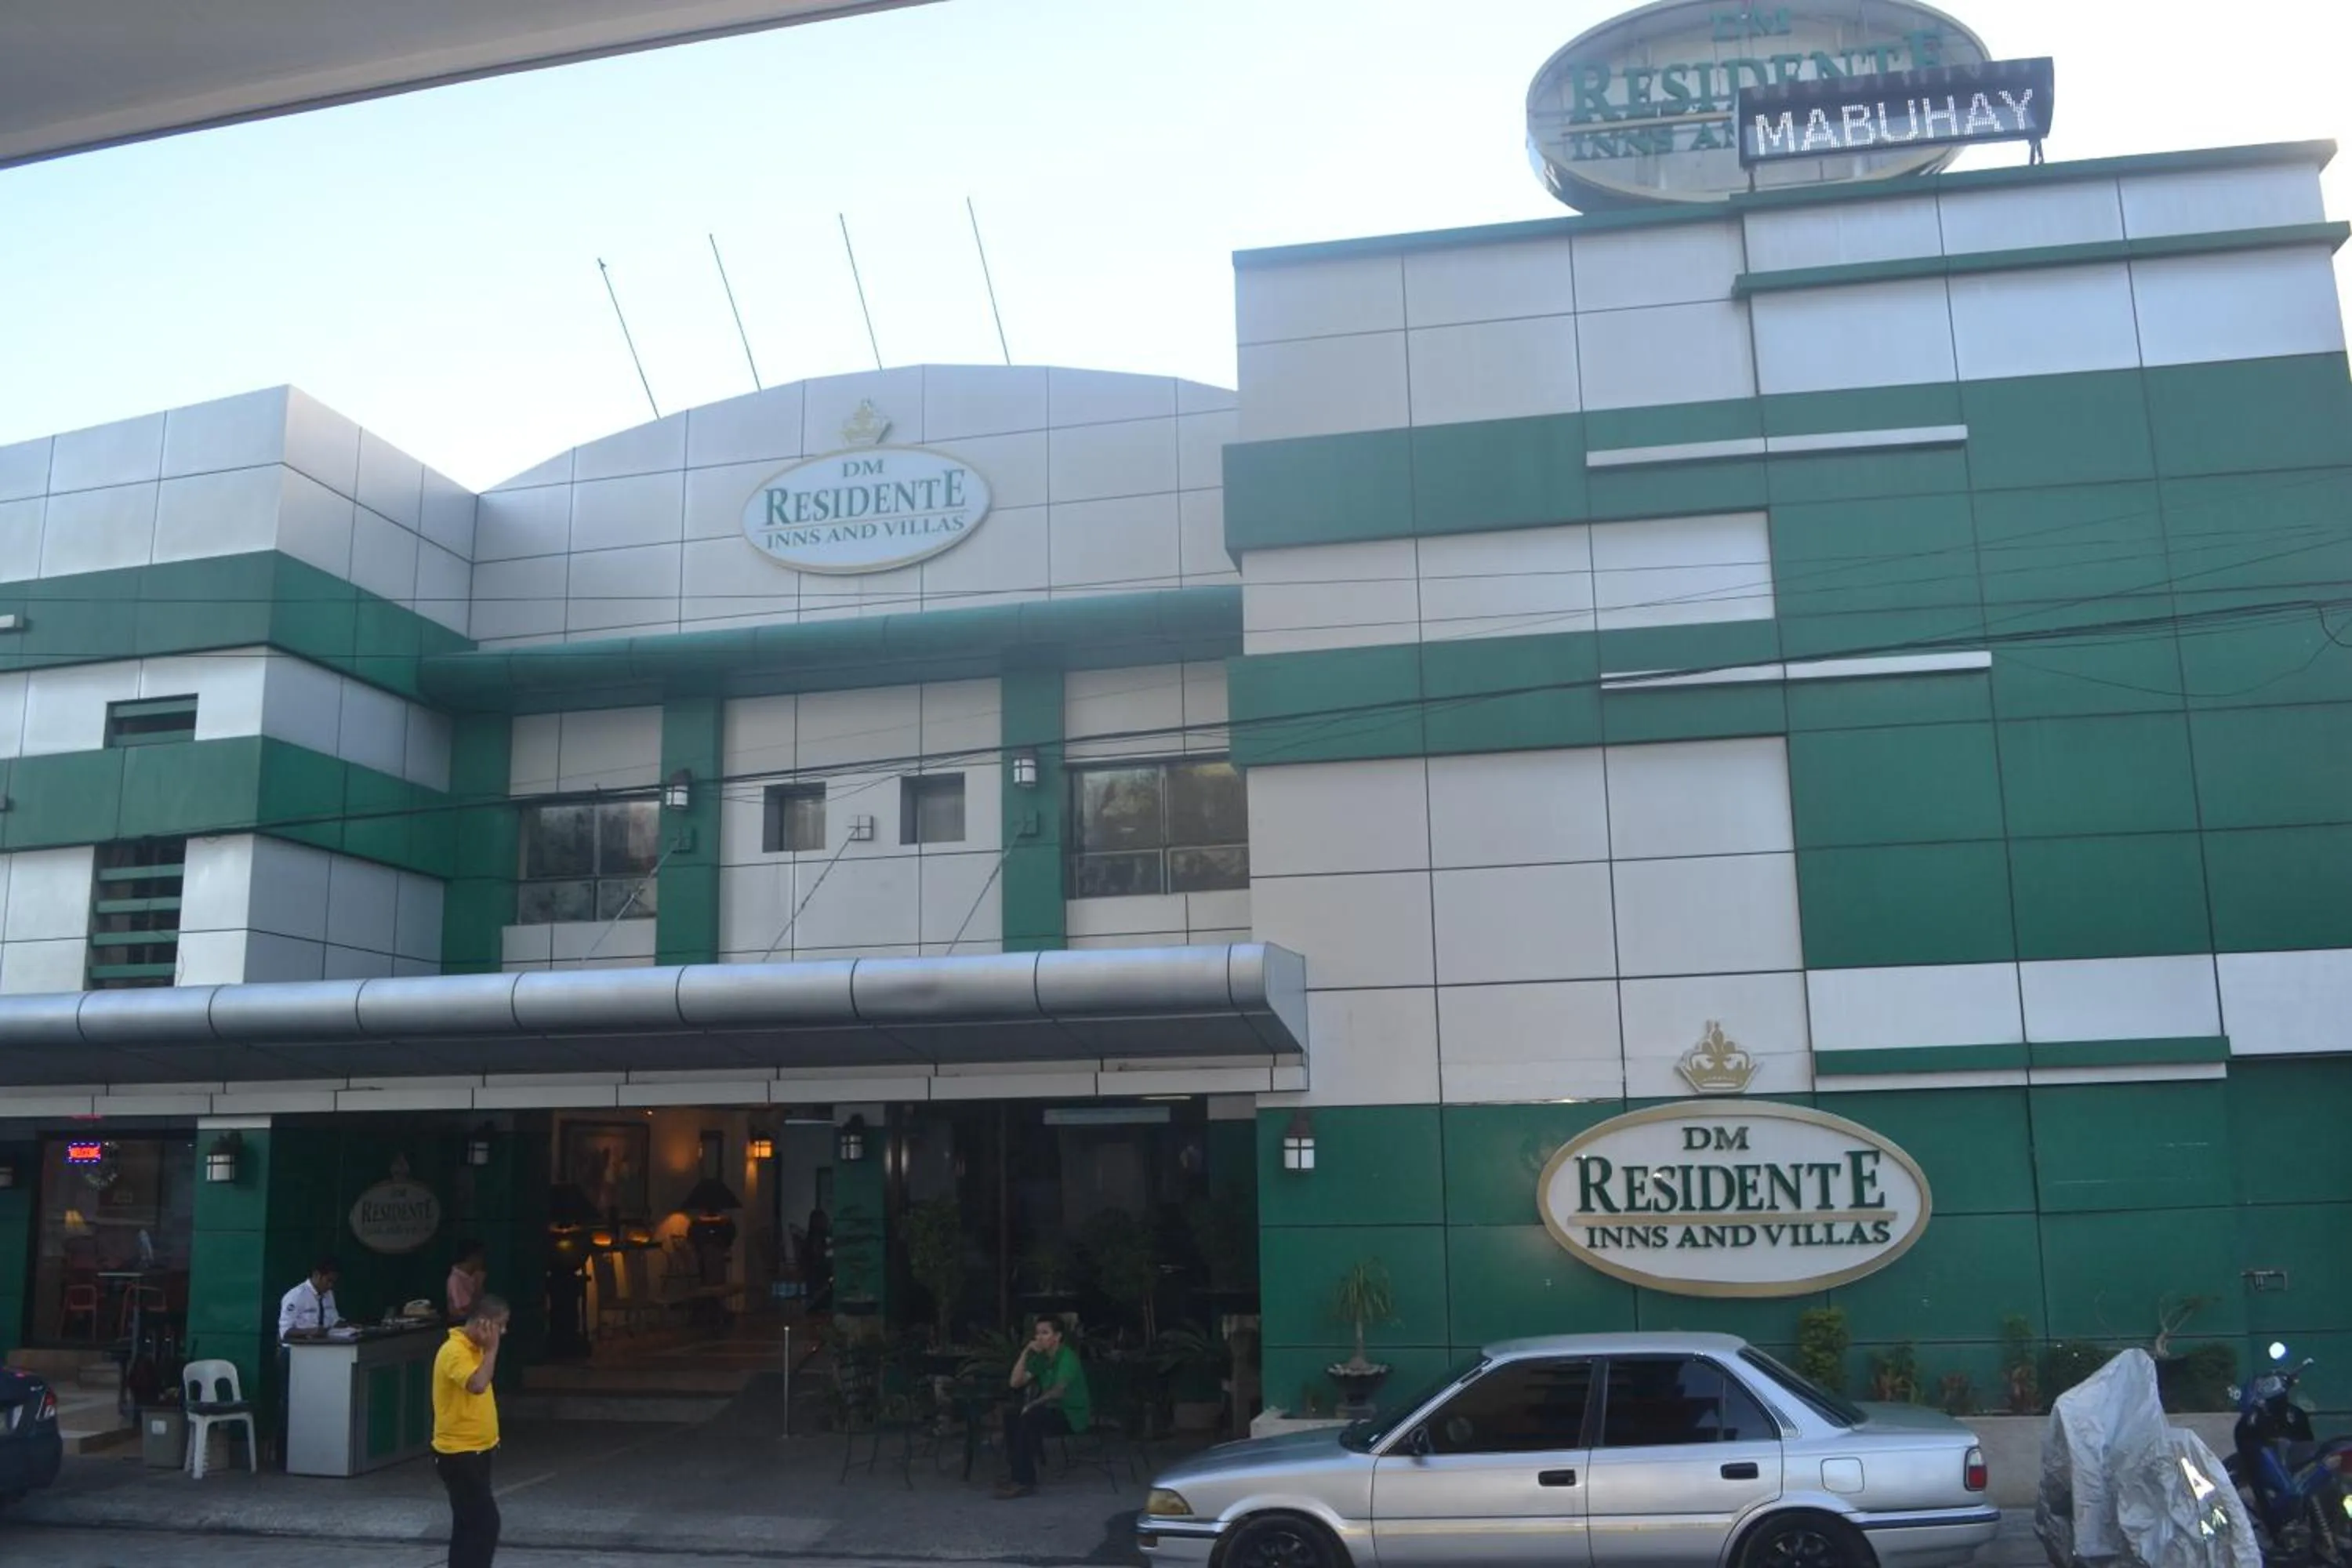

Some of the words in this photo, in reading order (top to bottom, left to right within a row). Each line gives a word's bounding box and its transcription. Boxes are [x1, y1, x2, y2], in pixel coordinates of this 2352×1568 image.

[1755, 88, 2034, 156] MABUHAY
[842, 459, 884, 478] DM
[764, 468, 966, 526] RESIDENTE
[767, 528, 821, 550] INNS
[827, 523, 877, 543] AND
[884, 514, 965, 538] VILLAS
[1682, 1127, 1750, 1152] DM
[1574, 1149, 1886, 1214] RESIDENTE
[1585, 1225, 1669, 1250] INNS
[1676, 1222, 1757, 1249] AND
[1759, 1219, 1891, 1247] VILLAS
